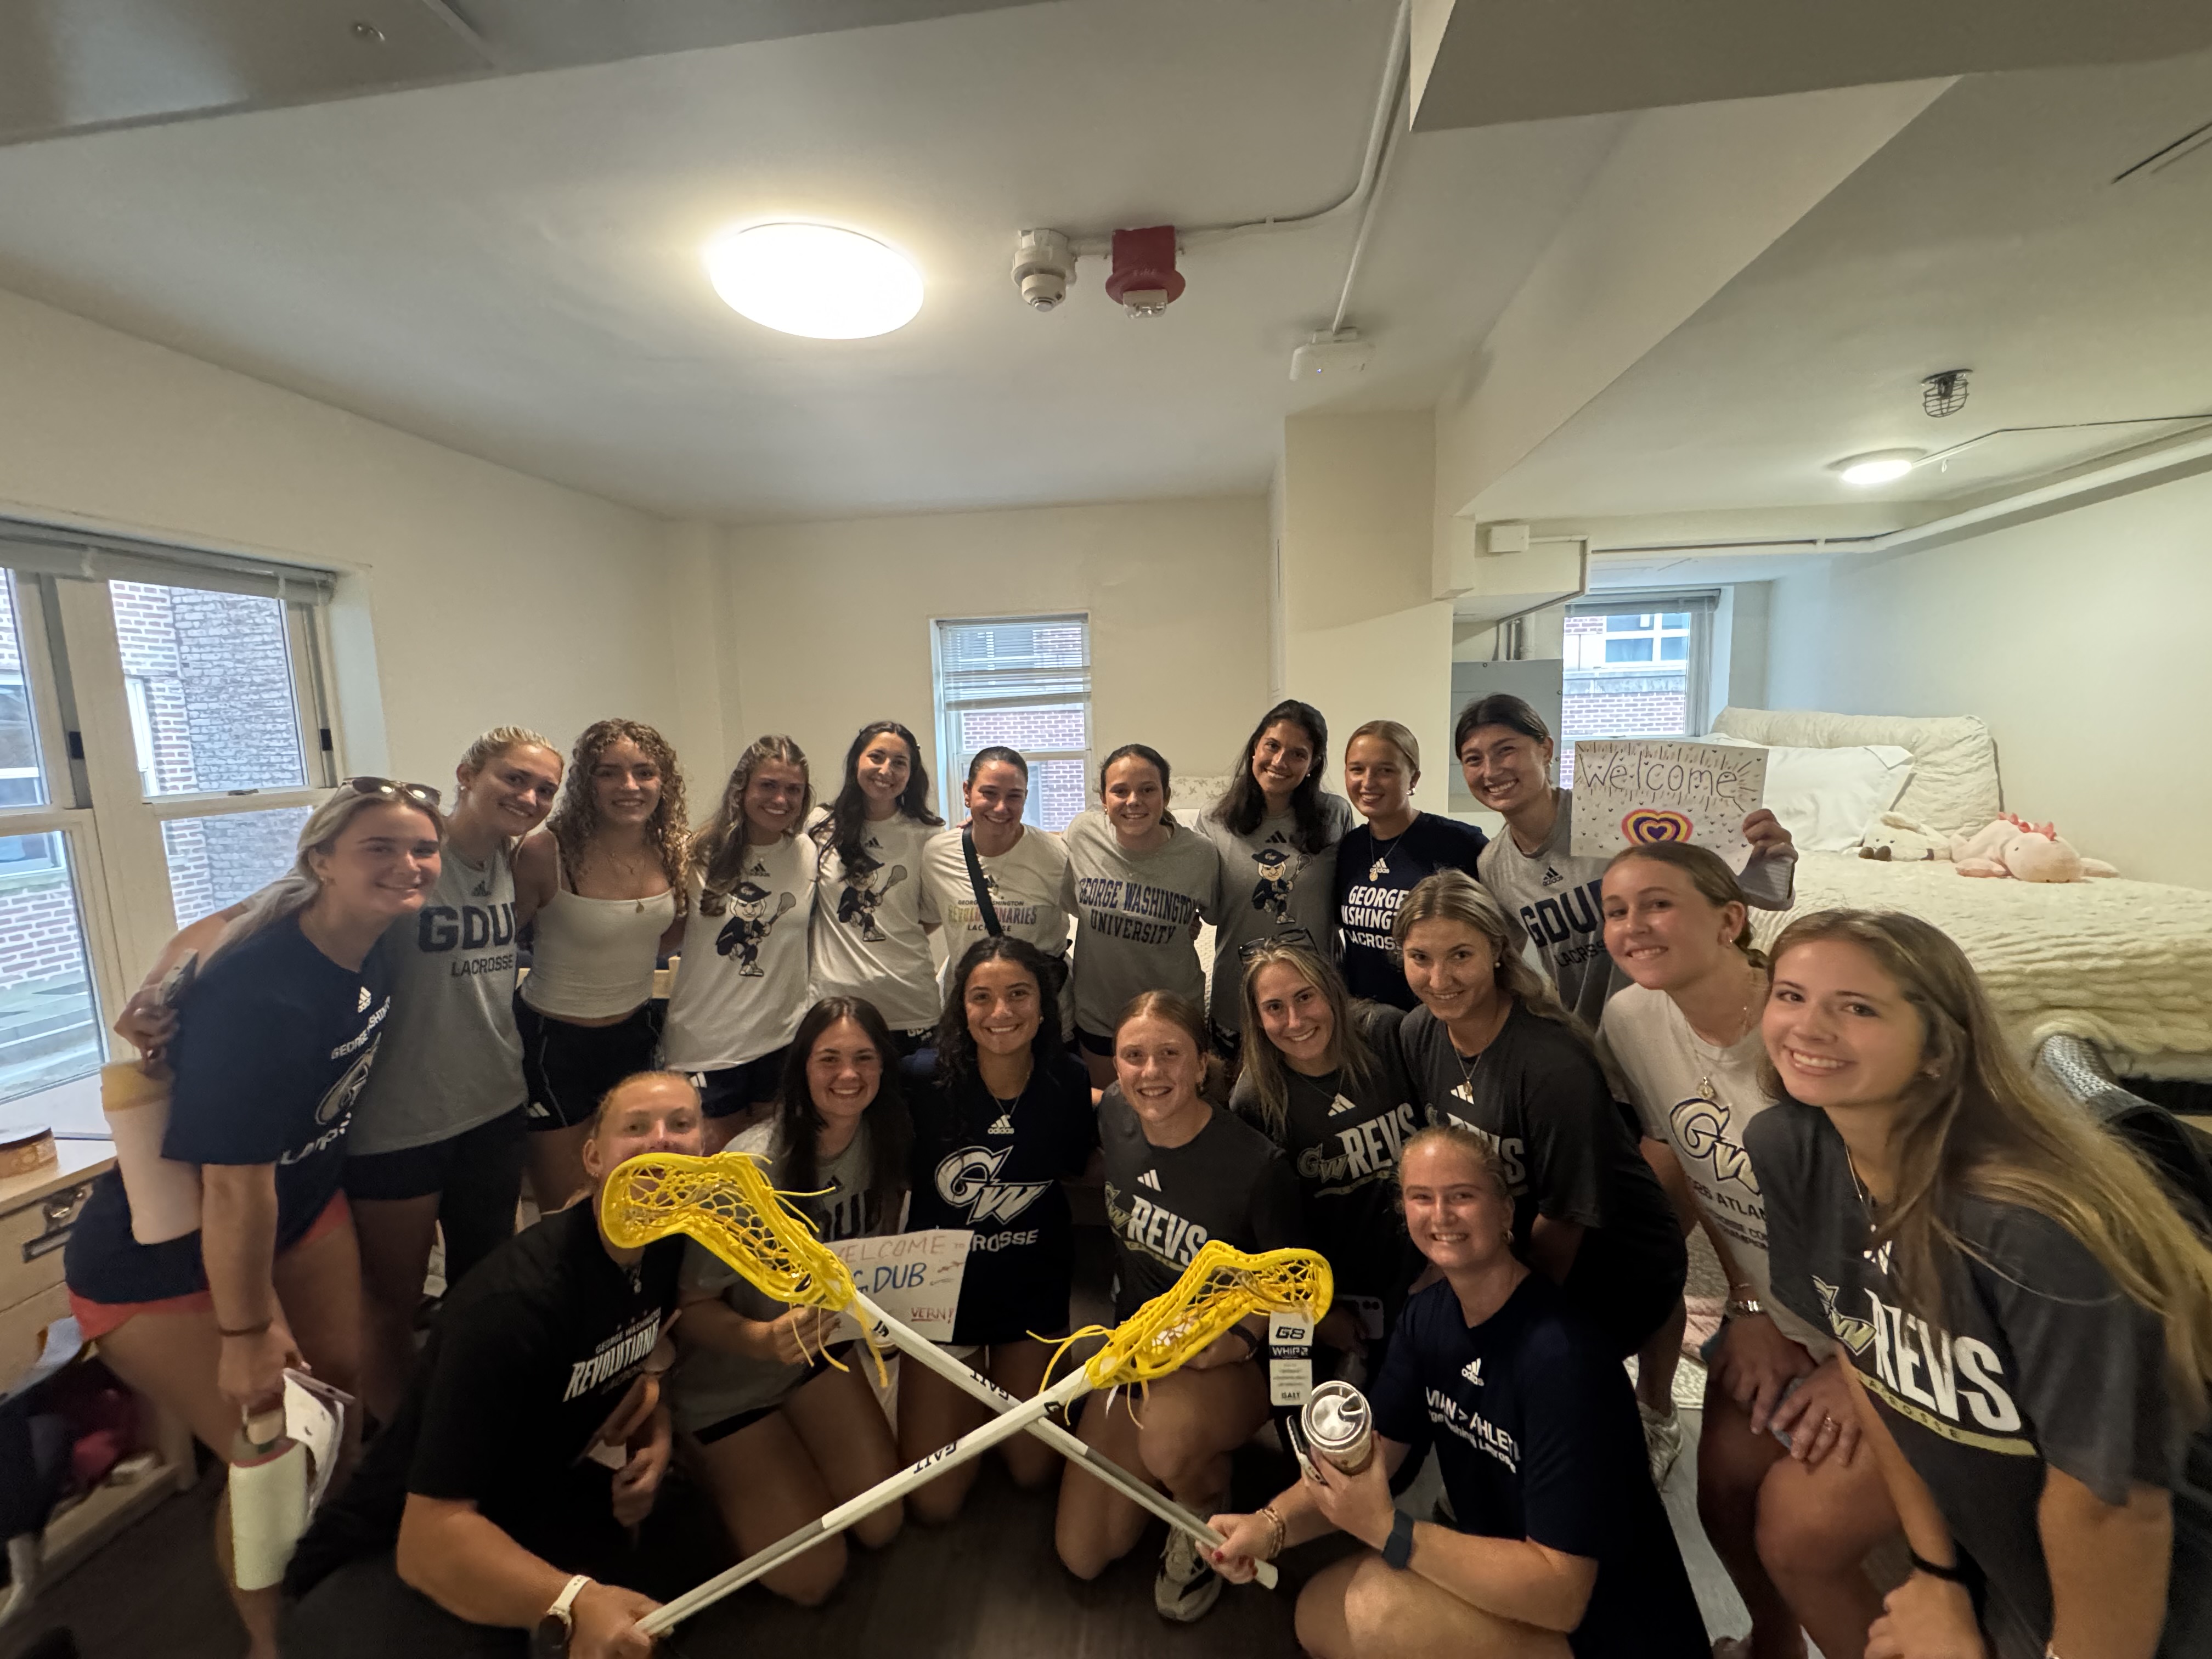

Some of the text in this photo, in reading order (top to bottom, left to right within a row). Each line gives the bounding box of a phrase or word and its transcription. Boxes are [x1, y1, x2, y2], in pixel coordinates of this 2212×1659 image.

[1579, 751, 1738, 799] Welcome
[1079, 877, 1123, 909] GEORGE
[1348, 885, 1410, 910] GEORGE
[948, 904, 1037, 925] REVOLUNARIES
[1090, 909, 1176, 945] UNIVERSITY
[935, 1145, 1054, 1226] GW
[972, 1229, 1040, 1252] ROSSE
[1127, 1194, 1208, 1267] REVS
[911, 1307, 956, 1324] VERN!
[1864, 1287, 2022, 1432] REVS
[913, 1441, 957, 1475] GAIT
